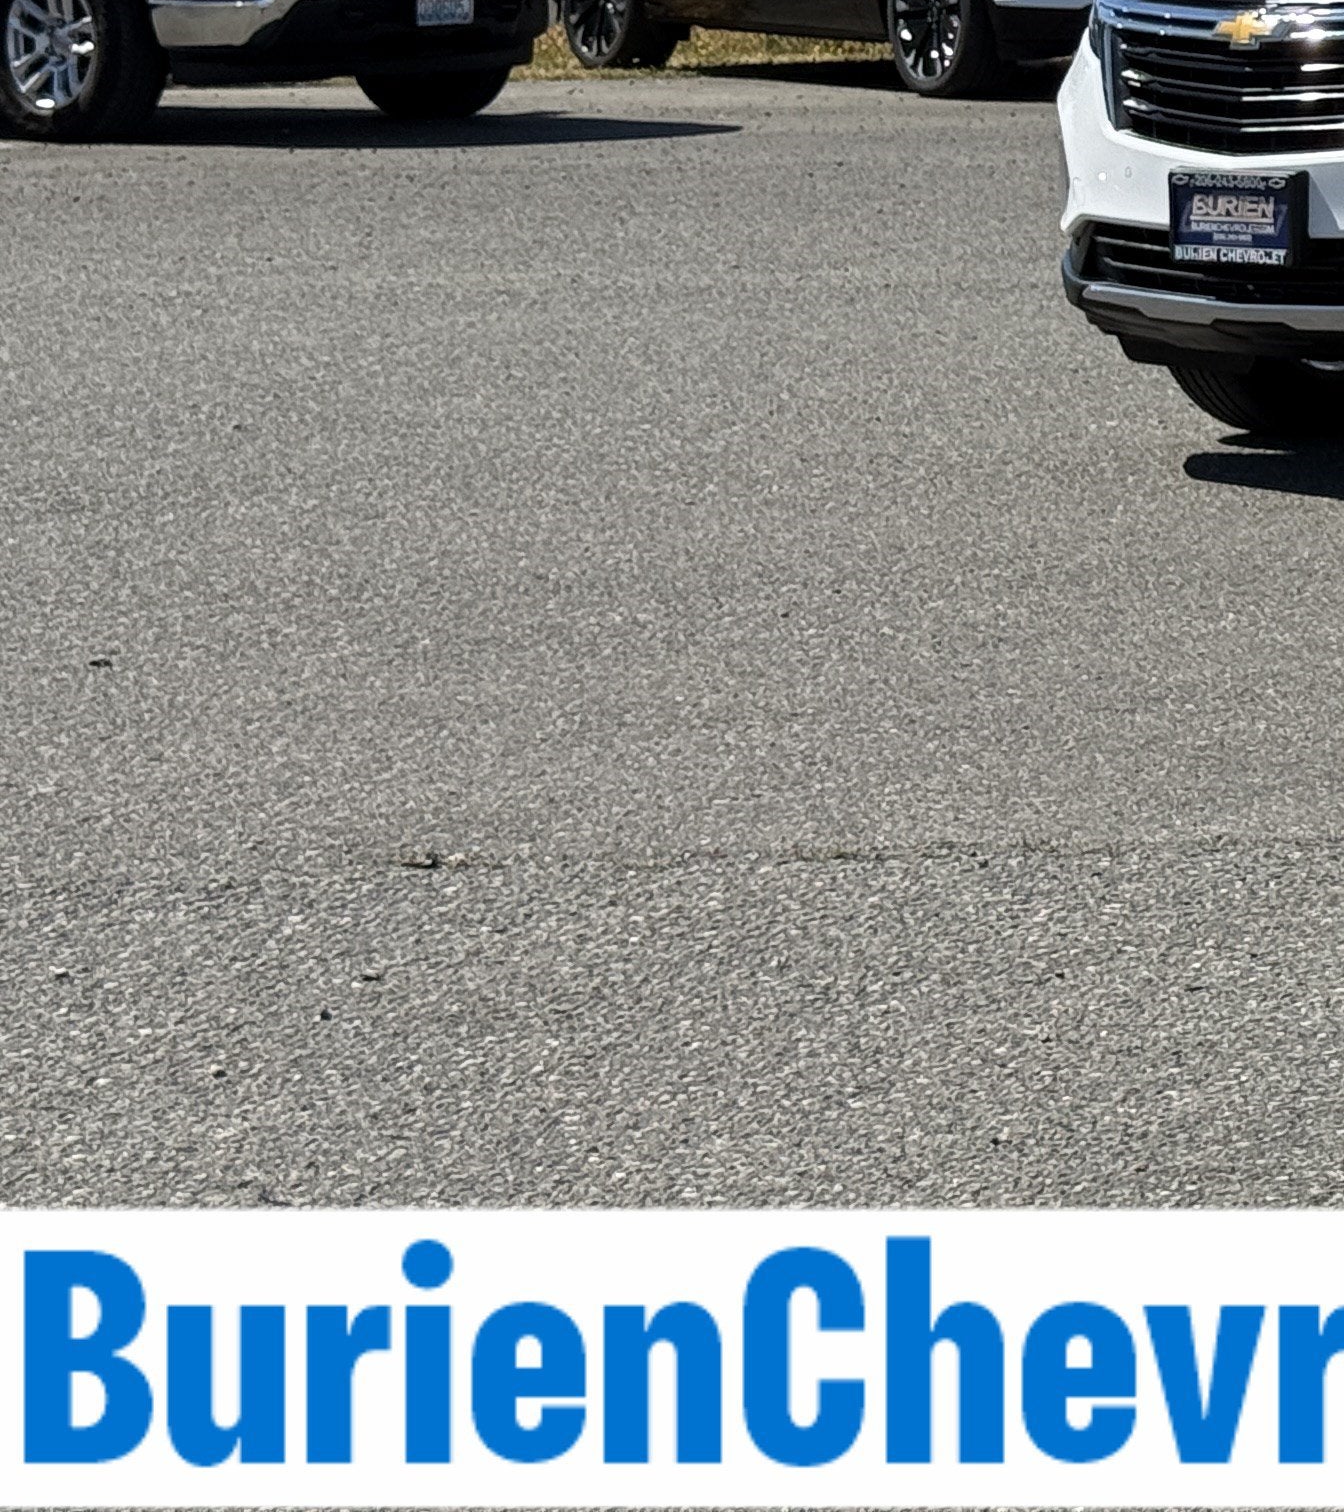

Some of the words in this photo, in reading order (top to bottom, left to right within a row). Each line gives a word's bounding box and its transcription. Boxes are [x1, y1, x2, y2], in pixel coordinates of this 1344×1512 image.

[1192, 194, 1275, 218] BURIEN
[1175, 245, 1218, 261] BURIEN
[1220, 248, 1287, 264] CHEVROLET
